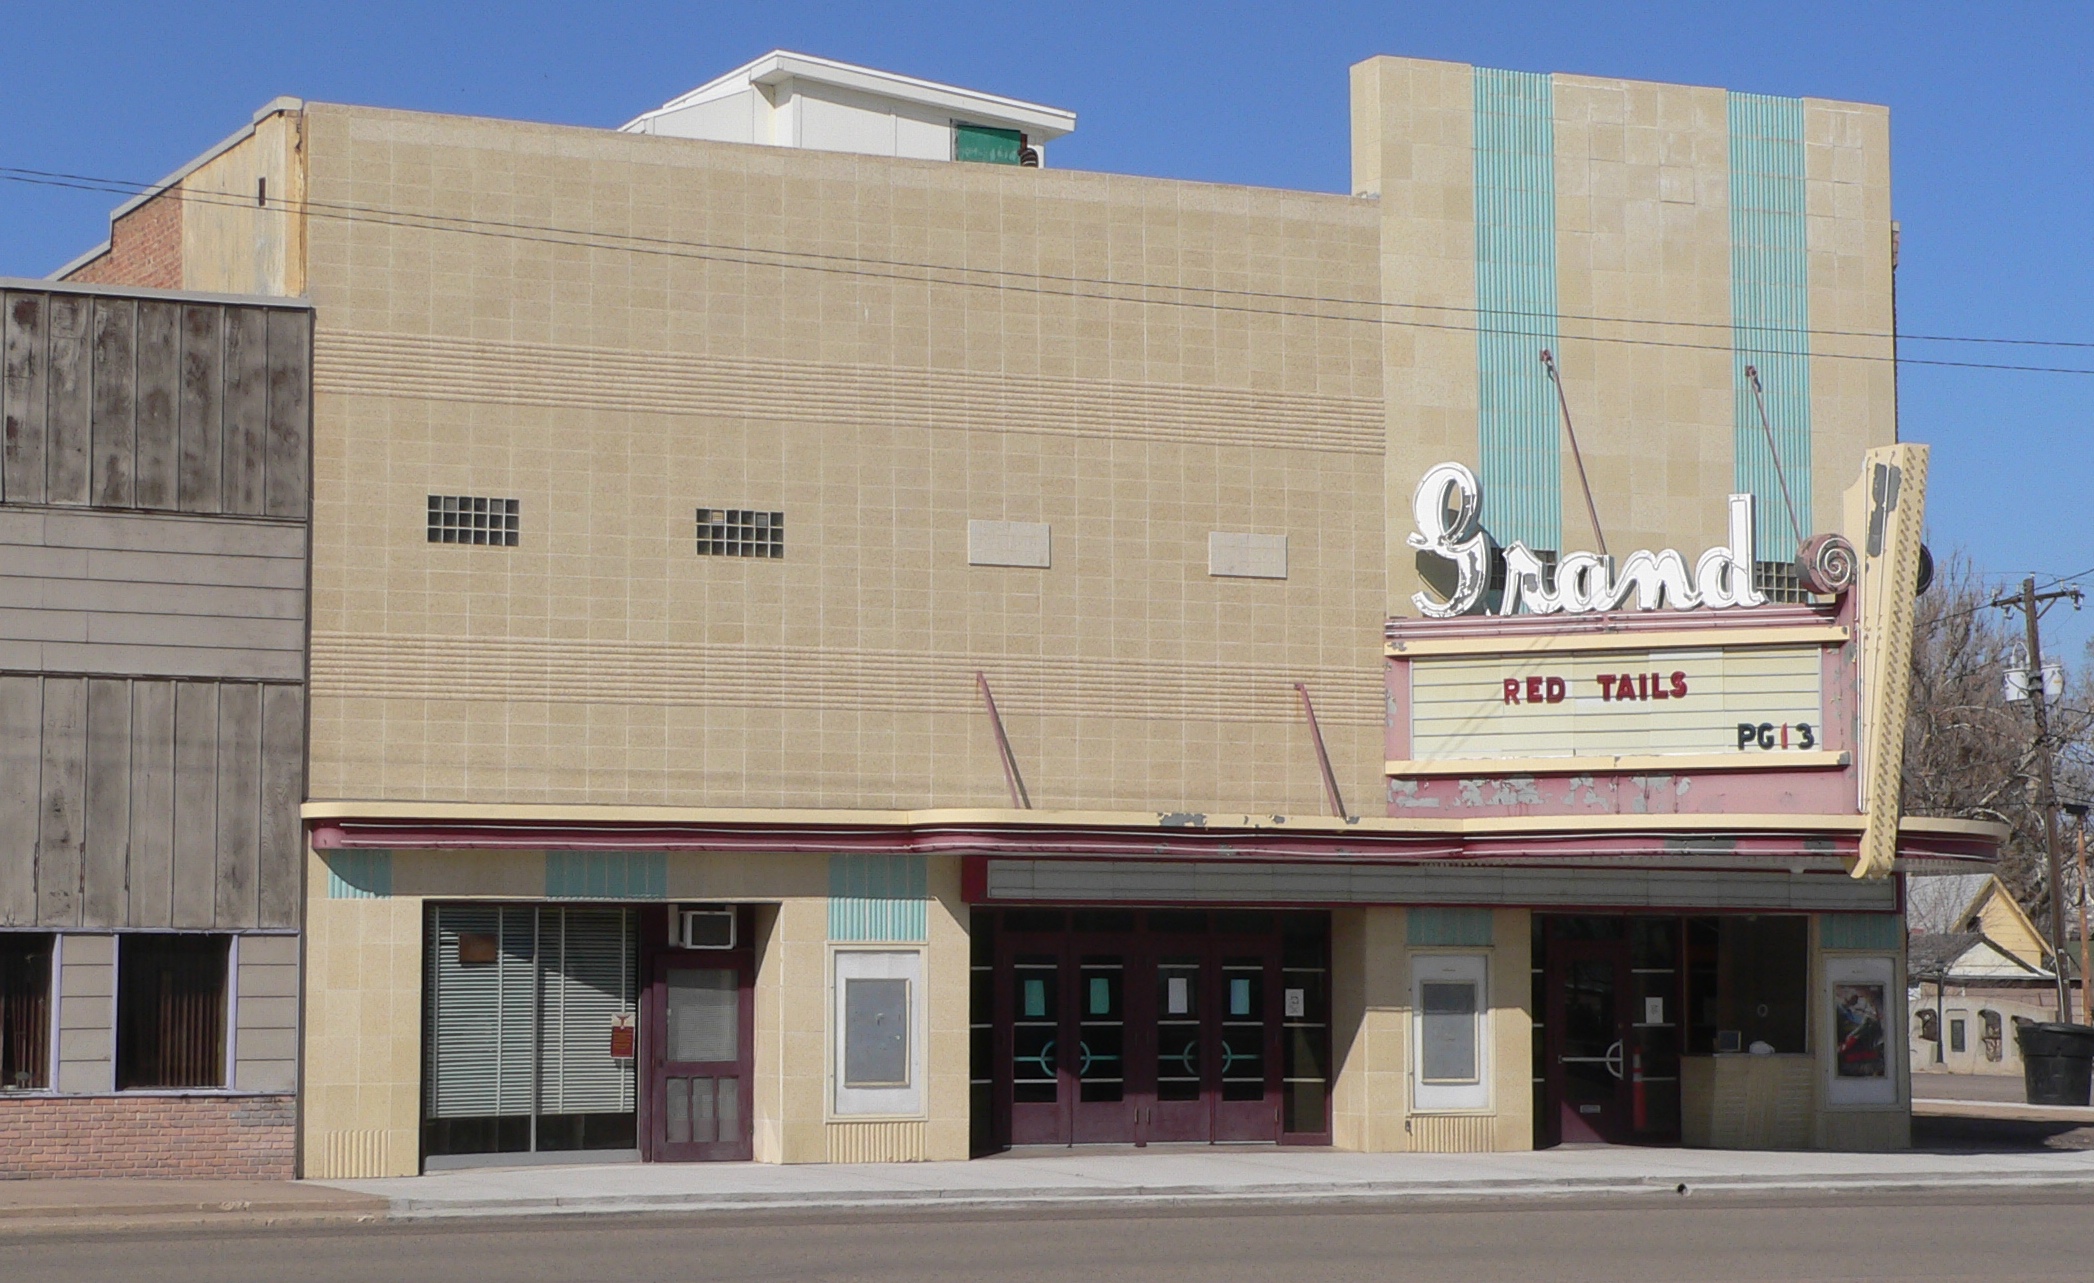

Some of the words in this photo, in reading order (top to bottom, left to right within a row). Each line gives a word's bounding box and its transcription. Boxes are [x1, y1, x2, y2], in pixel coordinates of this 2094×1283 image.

[1406, 461, 1769, 617] Grand
[1503, 676, 1566, 705] RED
[1597, 671, 1688, 702] TAILS
